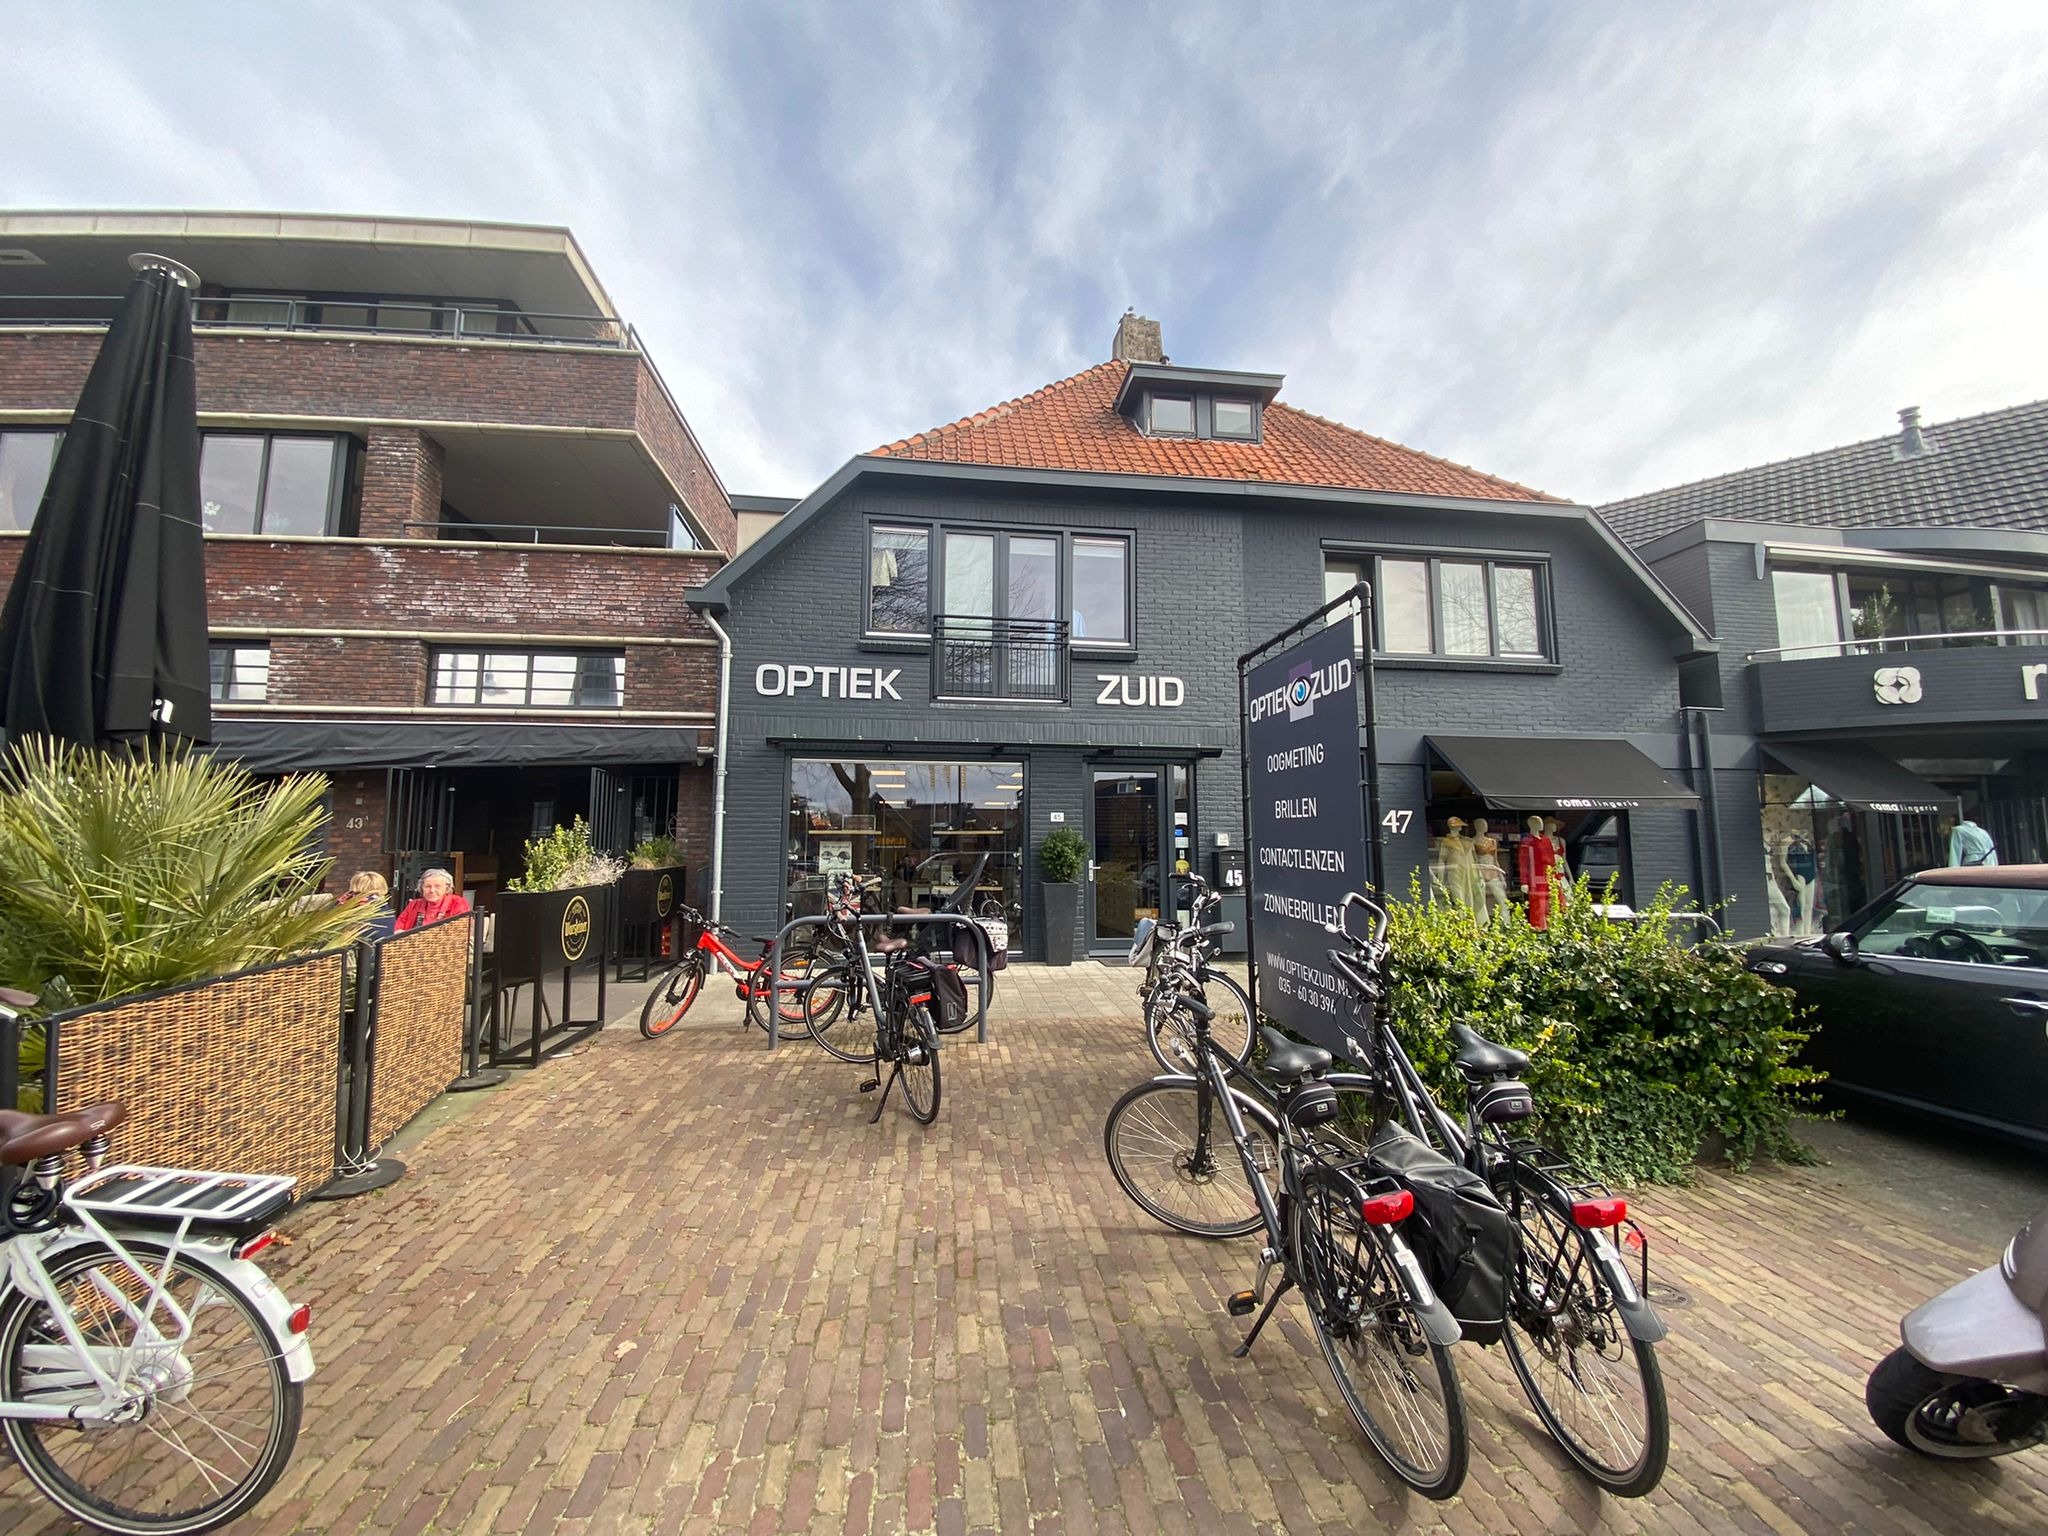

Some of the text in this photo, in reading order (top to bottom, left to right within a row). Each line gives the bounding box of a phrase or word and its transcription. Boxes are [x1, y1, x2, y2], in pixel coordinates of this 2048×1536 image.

[755, 663, 1184, 707] OPTIEK ZUID
[1250, 658, 1352, 723] OPTIEK ZUID
[1267, 743, 1324, 773] OOGMETING
[1275, 797, 1317, 820] BRILLEN
[1556, 799, 1639, 809] roma lingerie
[1382, 810, 1413, 834] 47
[1260, 847, 1345, 873] CONTACTLENZEN
[1225, 869, 1243, 887] 45
[1278, 976, 1291, 995] 035
[1308, 989, 1319, 1007] 30
